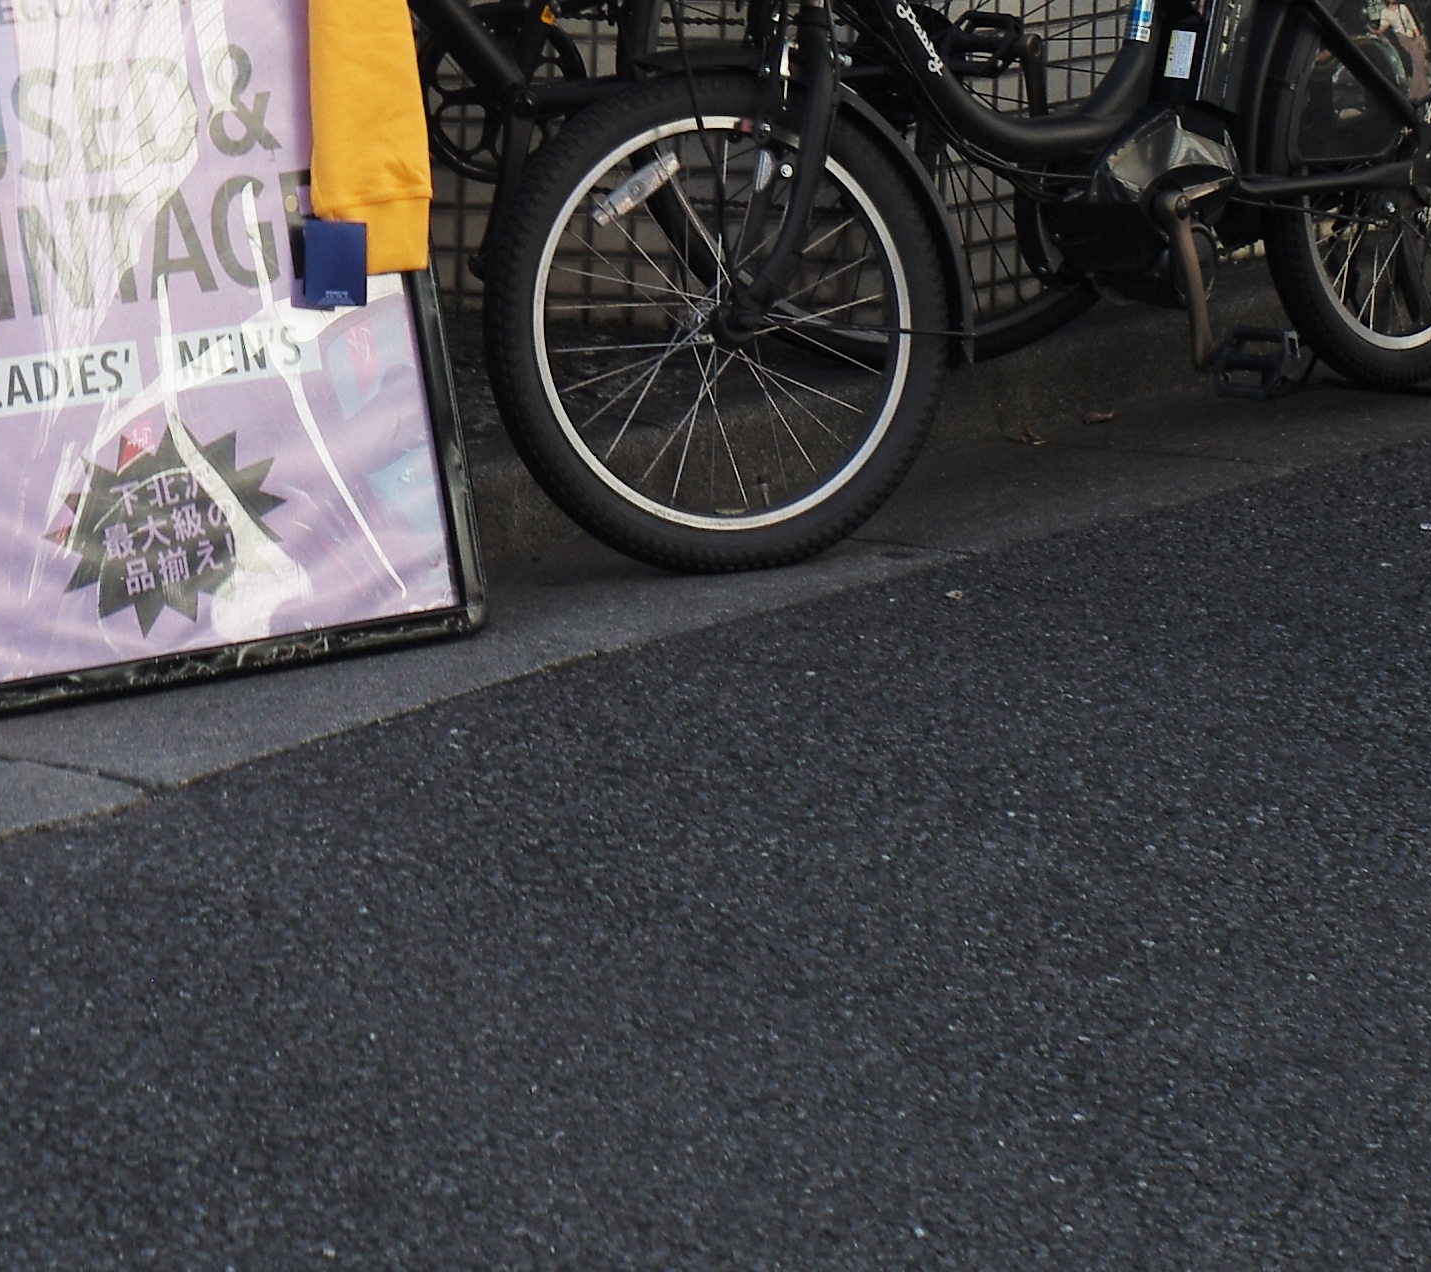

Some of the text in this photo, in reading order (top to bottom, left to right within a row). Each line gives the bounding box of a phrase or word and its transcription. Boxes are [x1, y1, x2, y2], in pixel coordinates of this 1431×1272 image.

[208, 43, 282, 156] &
[103, 498, 233, 561] 最大級の
